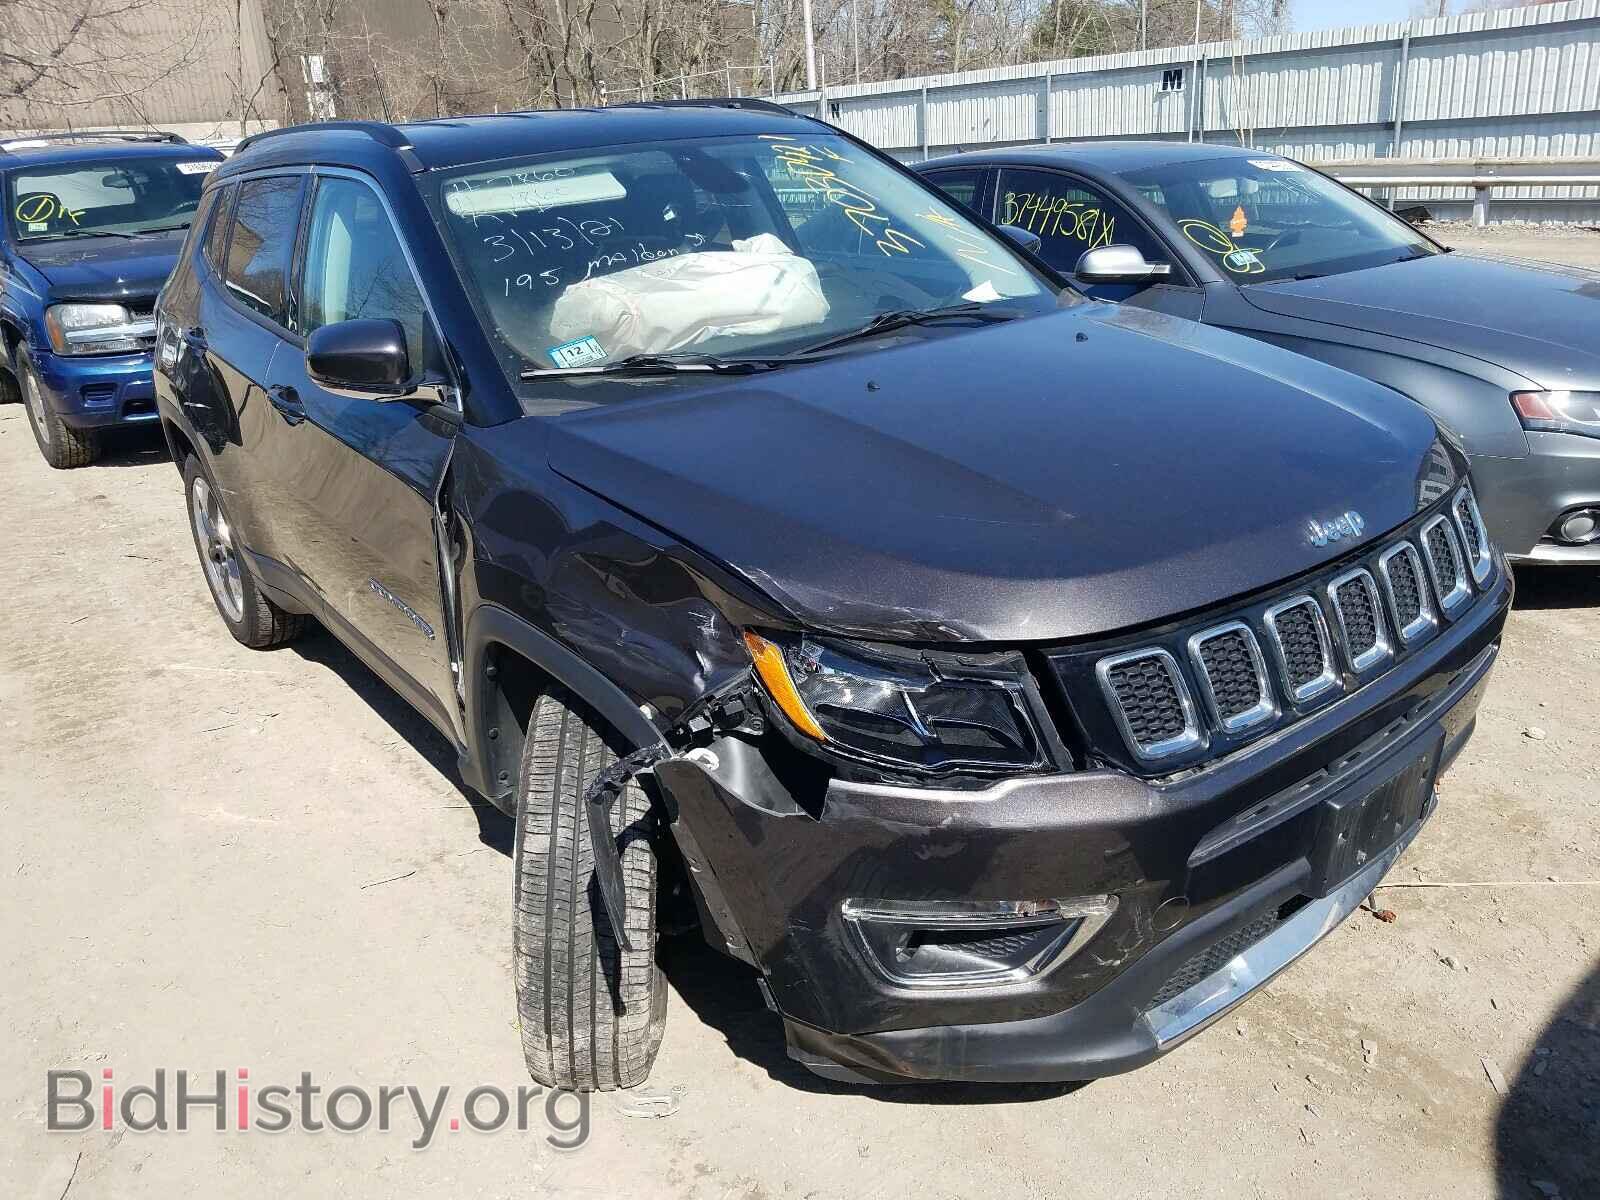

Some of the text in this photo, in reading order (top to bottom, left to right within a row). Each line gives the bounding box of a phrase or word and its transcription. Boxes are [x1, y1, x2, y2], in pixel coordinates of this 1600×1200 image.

[1162, 69, 1183, 91] M
[566, 345, 585, 357] 12
[1306, 510, 1365, 547] Jeep
